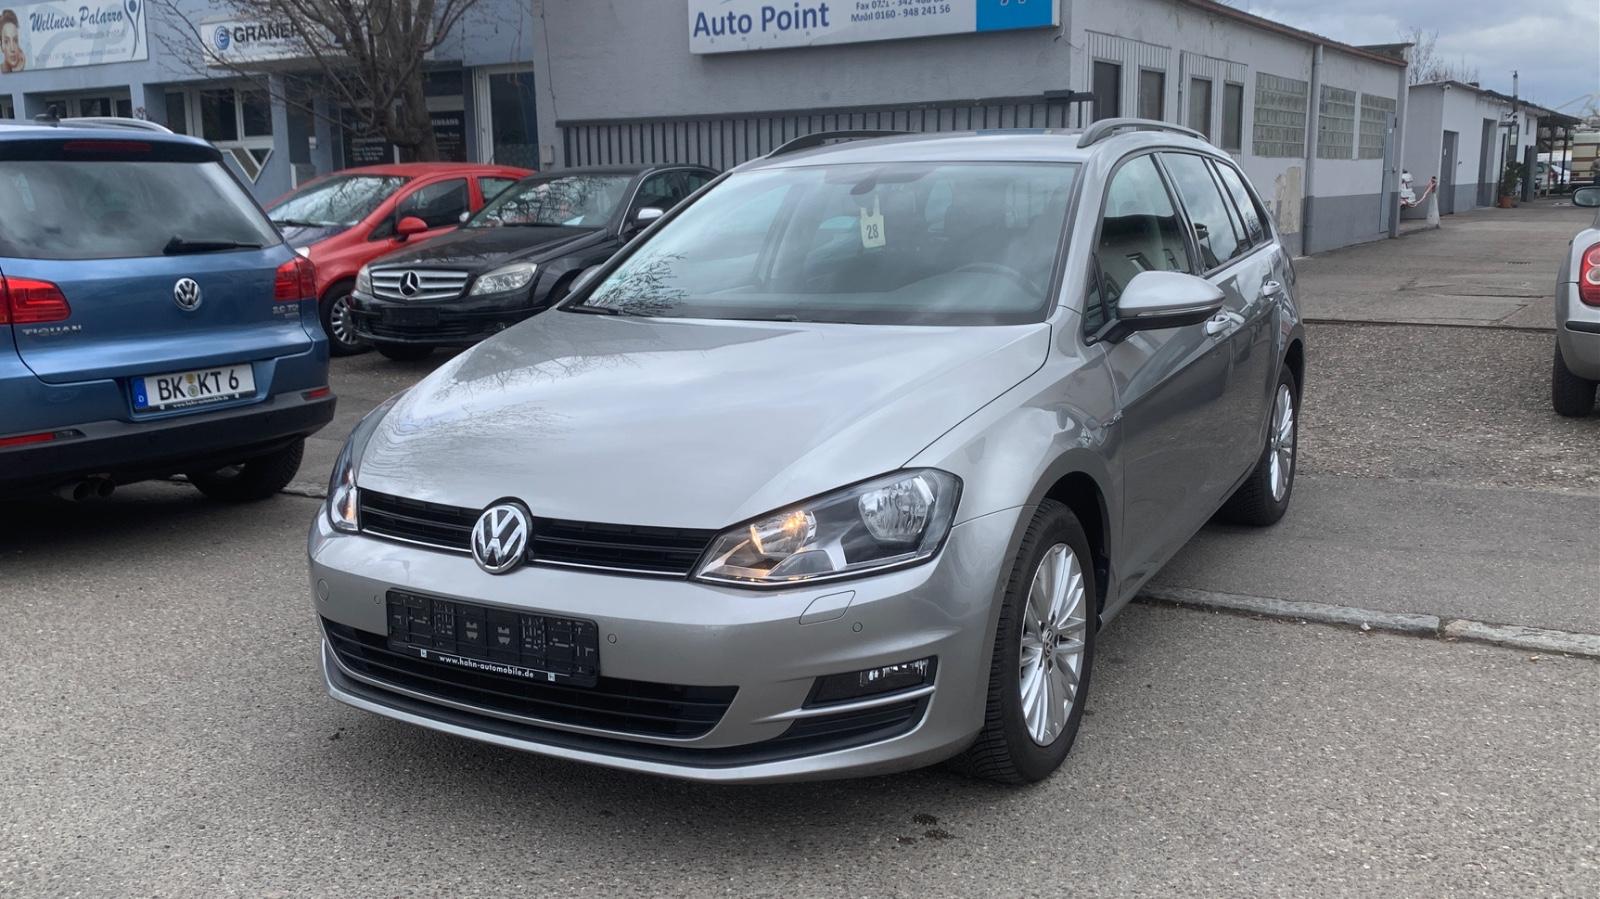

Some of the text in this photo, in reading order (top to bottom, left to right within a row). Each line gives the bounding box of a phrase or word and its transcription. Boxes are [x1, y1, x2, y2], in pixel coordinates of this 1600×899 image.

[856, 1, 870, 11] Fax
[875, 9, 896, 20] 0160
[903, 8, 919, 18] 948
[921, 6, 937, 16] 241
[939, 4, 951, 14] 56
[30, 12, 75, 32] Wellness
[693, 2, 830, 37] Auto Point
[866, 223, 879, 240] 28
[157, 375, 187, 401] BK
[197, 370, 222, 395] KT
[228, 368, 240, 391] 6
[439, 655, 534, 678] www.hahn-automobile.de
